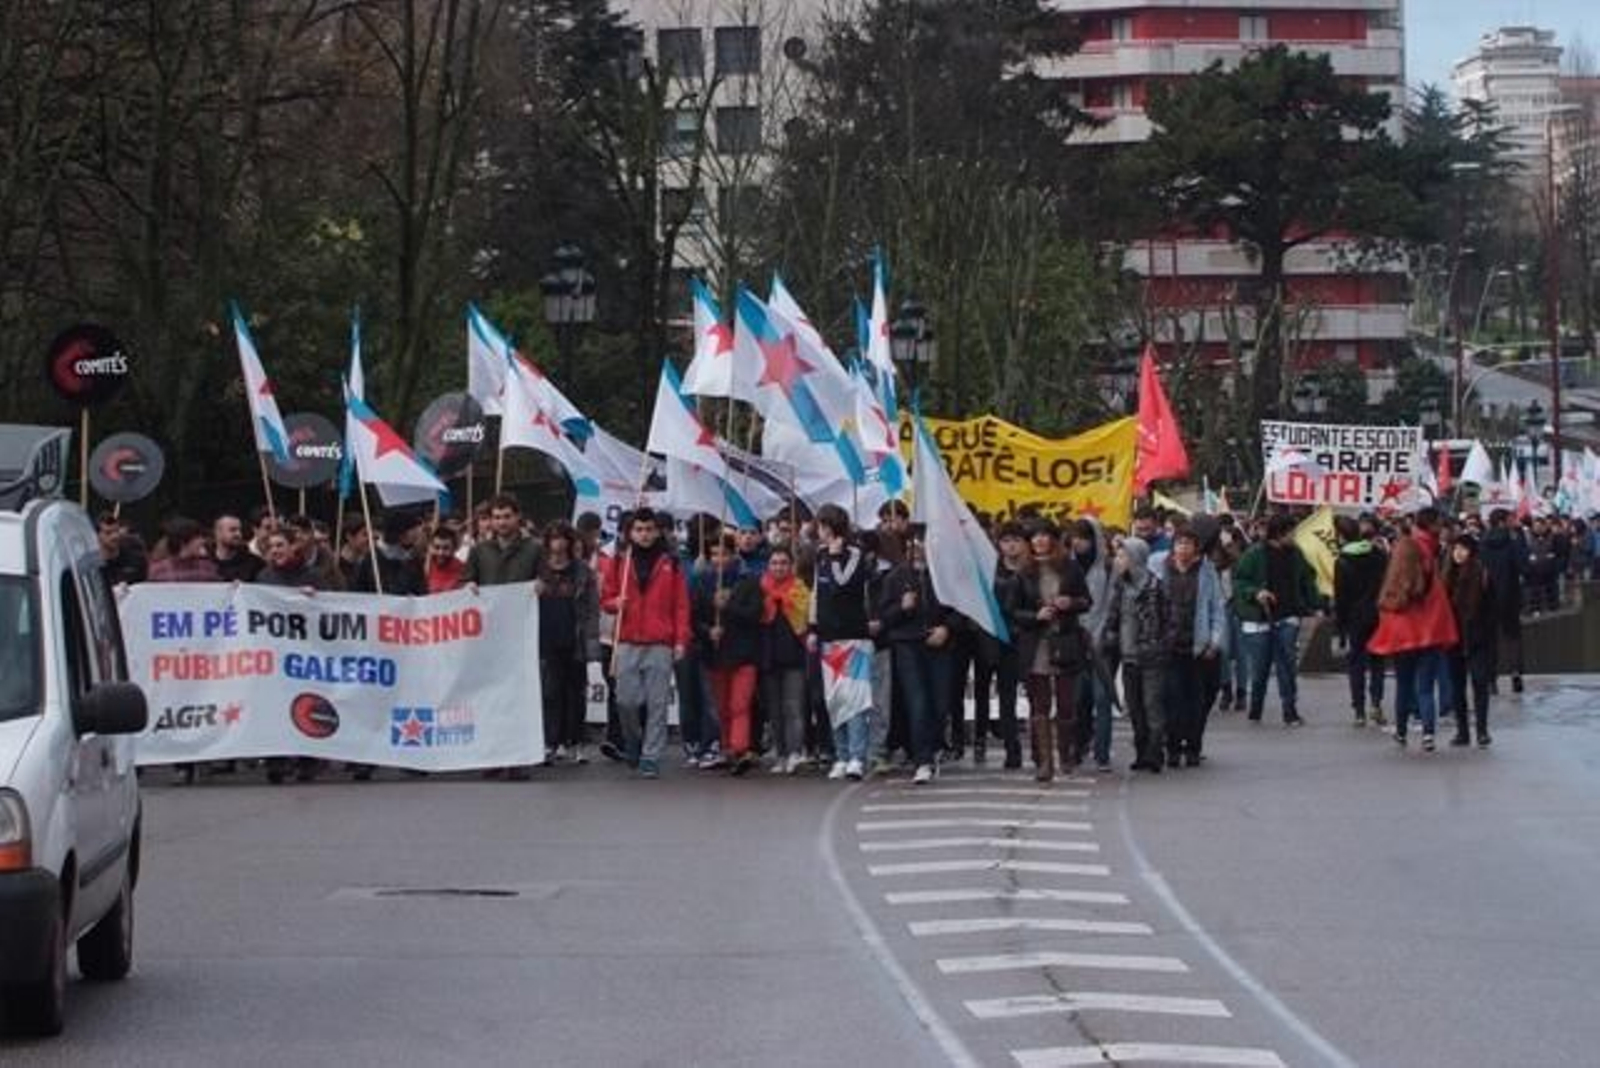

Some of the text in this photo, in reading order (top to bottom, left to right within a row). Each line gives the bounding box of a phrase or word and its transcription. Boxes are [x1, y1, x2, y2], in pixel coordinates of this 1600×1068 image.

[75, 351, 127, 375] COMITÉS
[151, 604, 483, 645] EM PÉ POR UM ENSINO
[152, 647, 397, 687] PÚBLICO GALEGO
